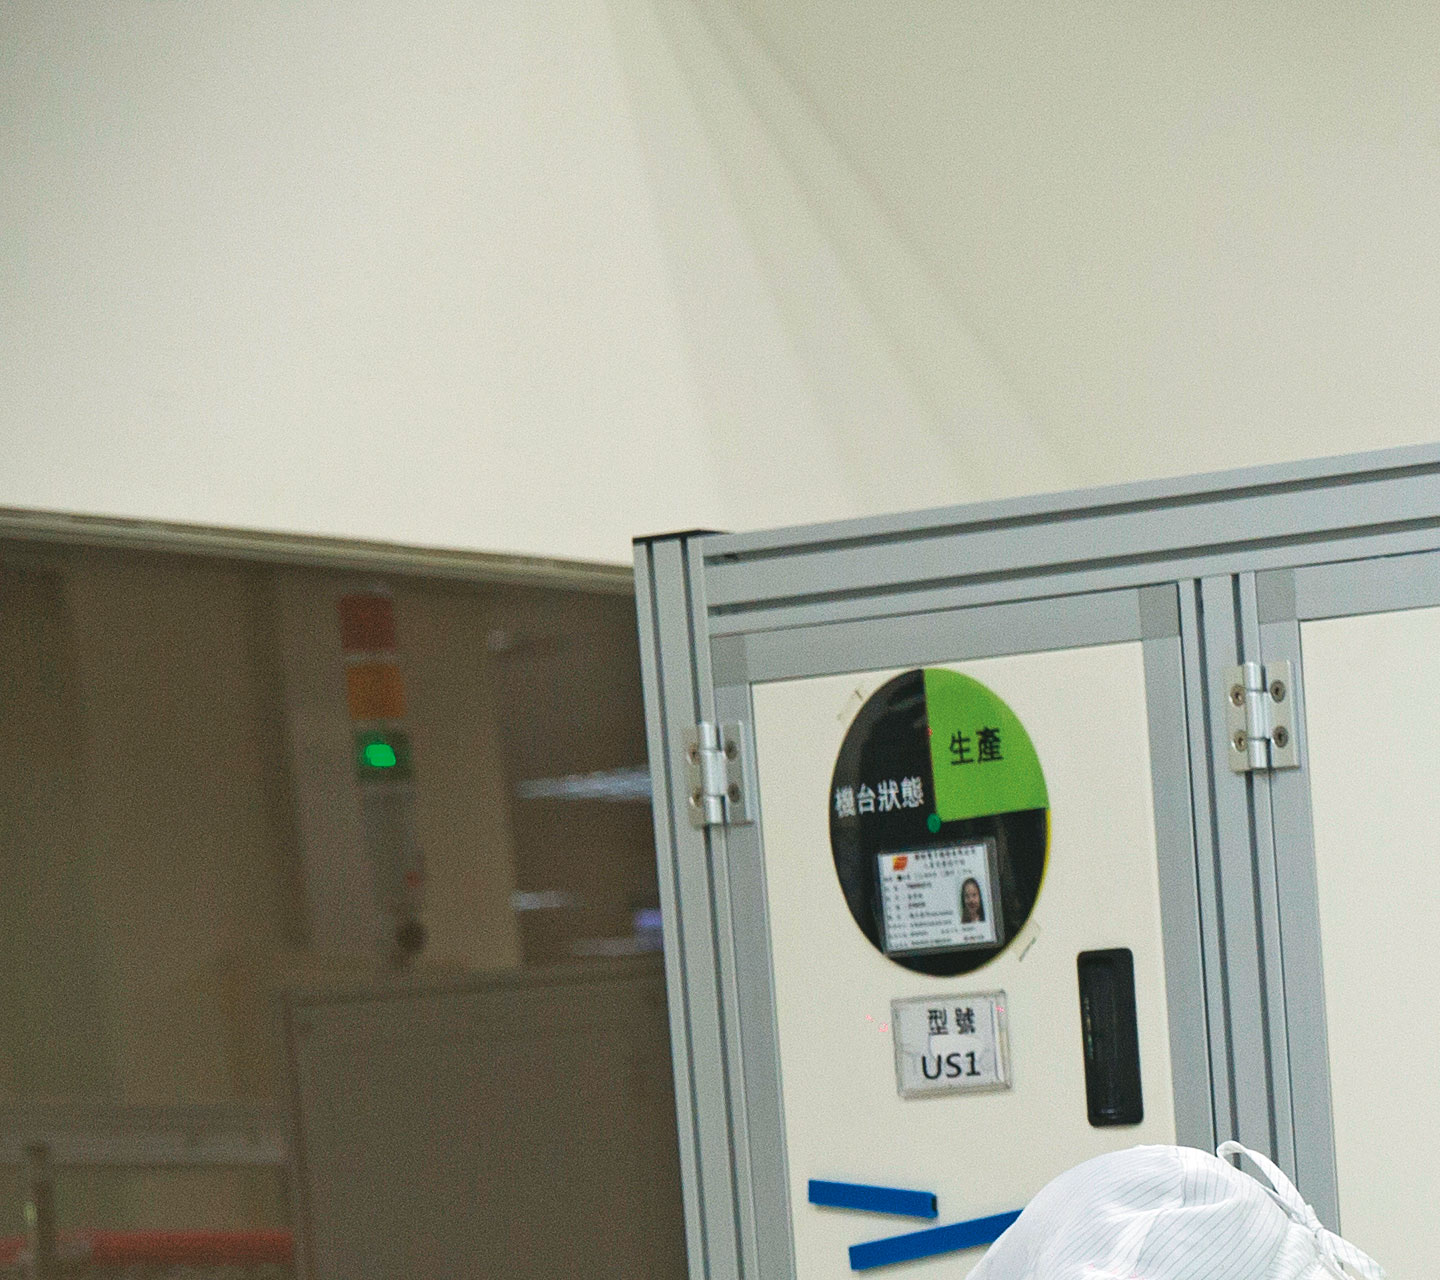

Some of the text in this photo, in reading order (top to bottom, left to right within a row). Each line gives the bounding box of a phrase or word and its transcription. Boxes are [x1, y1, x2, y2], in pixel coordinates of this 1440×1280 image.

[949, 726, 1004, 766] 生產
[835, 776, 924, 819] 機台狀態
[927, 1007, 976, 1036] 型號
[921, 1052, 982, 1080] US1
